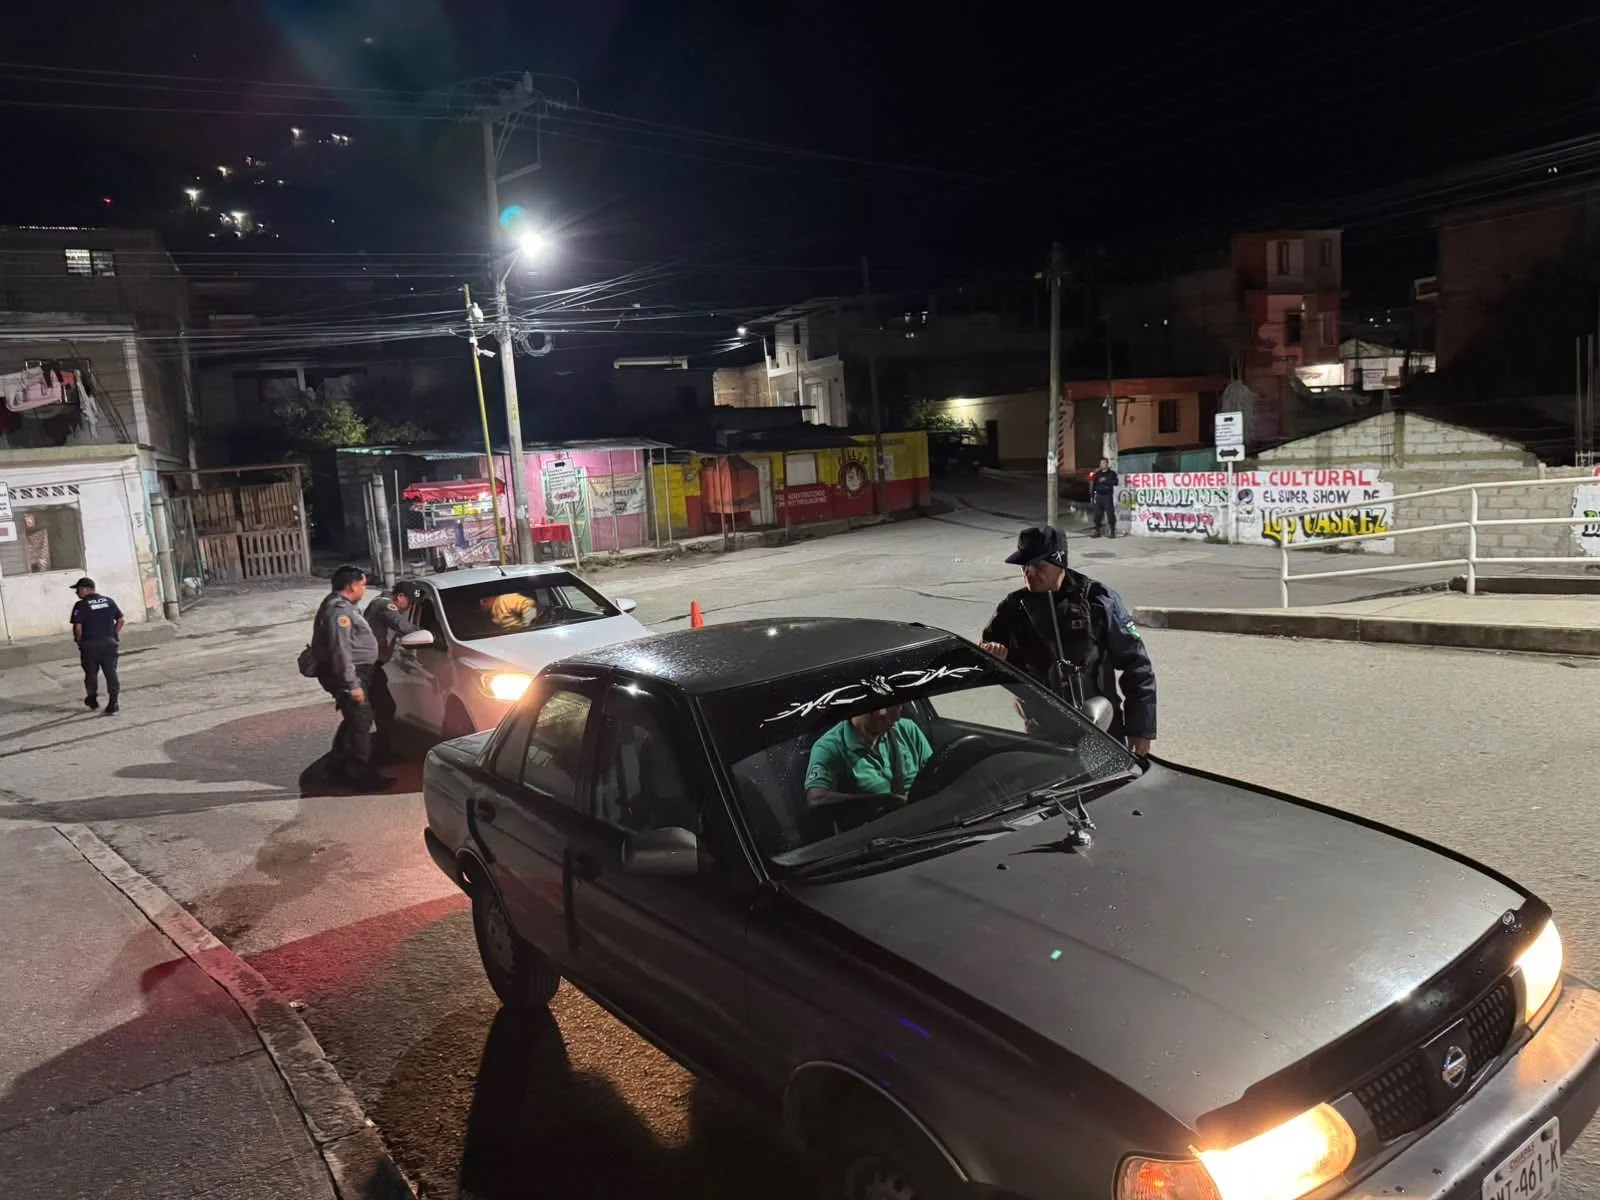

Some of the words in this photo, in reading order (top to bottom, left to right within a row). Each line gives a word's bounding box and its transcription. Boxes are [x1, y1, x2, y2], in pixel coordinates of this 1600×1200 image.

[1124, 473, 1167, 488] FERIA
[1172, 471, 1261, 487] COMERIAL
[1269, 470, 1372, 487] CULTURAL
[1263, 490, 1276, 503] EL
[1278, 490, 1309, 503] SUPER
[1313, 490, 1350, 503] SHOW
